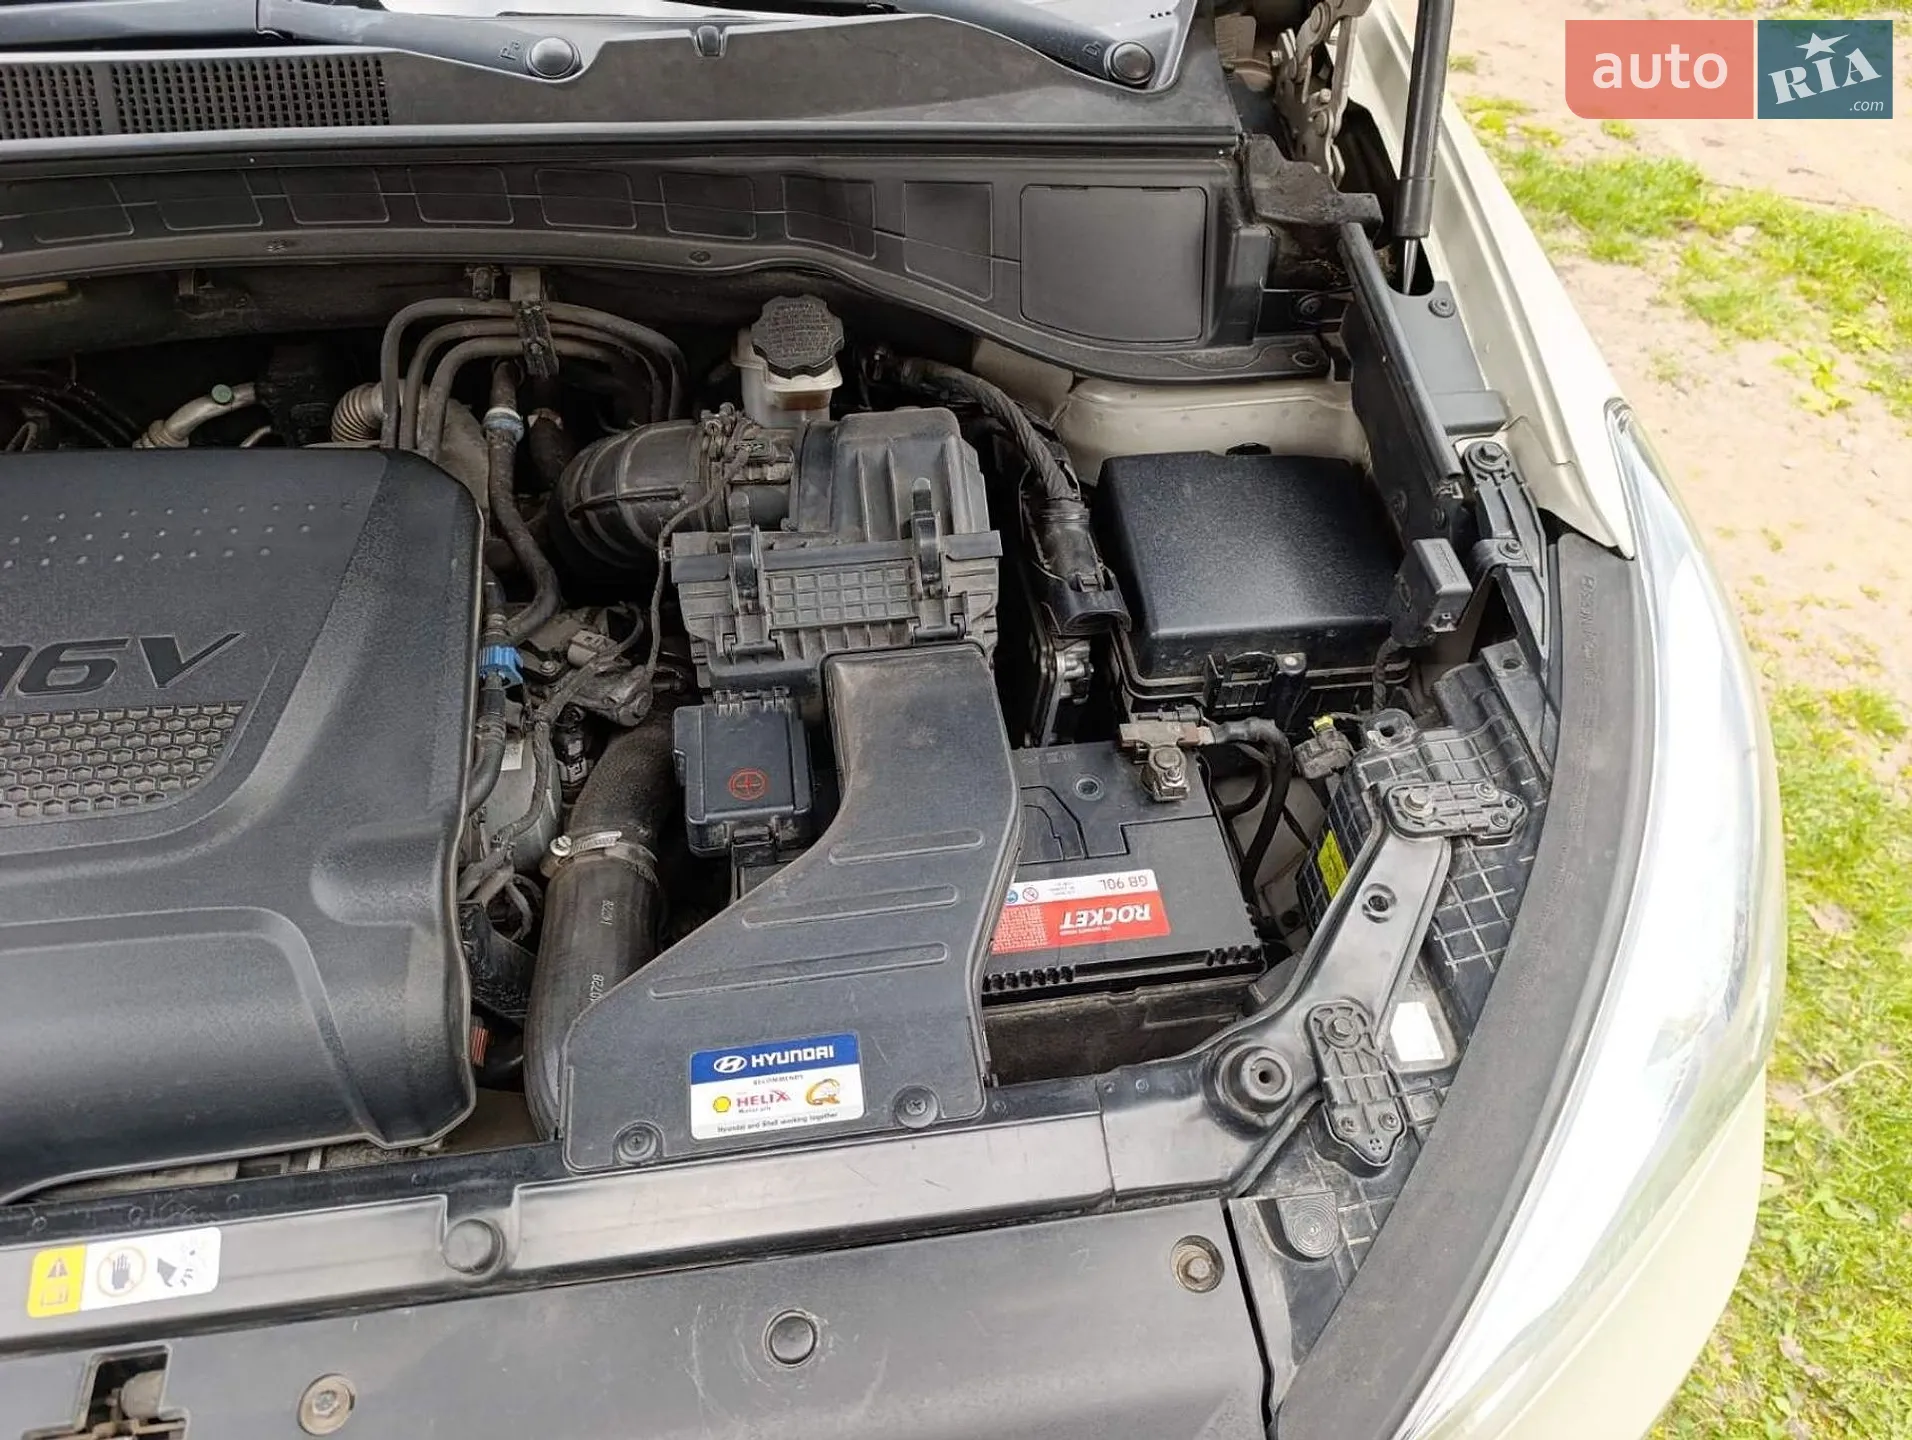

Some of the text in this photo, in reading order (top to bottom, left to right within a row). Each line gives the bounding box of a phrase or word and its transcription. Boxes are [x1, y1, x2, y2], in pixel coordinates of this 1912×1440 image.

[1059, 903, 1151, 930] ROCKET
[751, 1045, 835, 1068] HYUNDAI
[736, 1089, 792, 1108] HELIX
